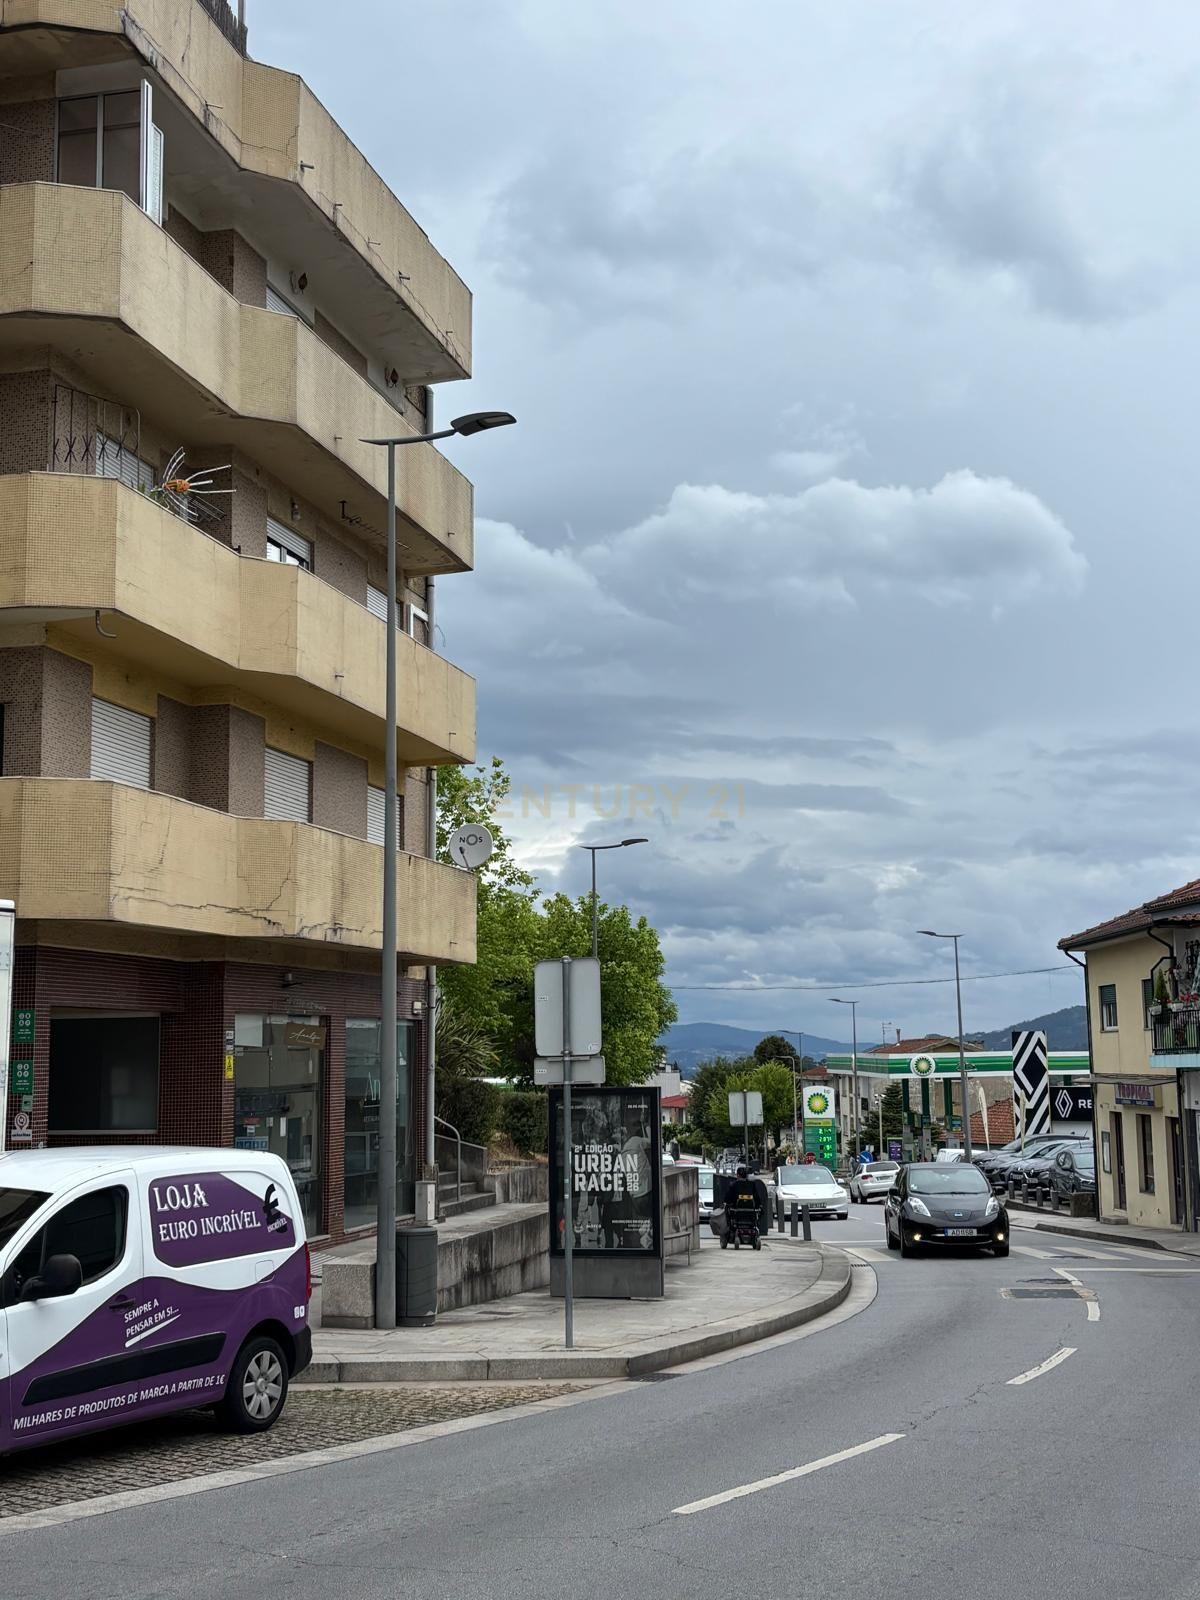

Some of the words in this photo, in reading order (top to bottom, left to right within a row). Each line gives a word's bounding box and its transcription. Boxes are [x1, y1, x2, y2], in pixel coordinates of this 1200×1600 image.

[459, 834, 484, 846] NOS
[1078, 1099, 1092, 1109] RE
[585, 1143, 613, 1155] EDIÇÃO
[574, 1153, 639, 1172] URBAN
[574, 1173, 624, 1192] RACE
[626, 1173, 639, 1182] 20
[626, 1182, 639, 1192] 26
[153, 1183, 209, 1212] LOJA
[159, 1219, 198, 1242] EURO
[200, 1209, 261, 1236] INCRÍVEL
[124, 1301, 152, 1323] SEMPRE
[153, 1298, 159, 1308] A
[126, 1316, 153, 1338] PENSAR
[154, 1309, 166, 1323] EM
[13, 1409, 63, 1430] MILHARES
[64, 1406, 77, 1419] DE
[78, 1395, 126, 1416] PRODUTOS
[127, 1392, 139, 1404] DE
[140, 1384, 169, 1401] MARCA
[170, 1383, 177, 1394] A
[177, 1378, 204, 1392] PARTIR
[204, 1375, 216, 1387] DE
[215, 1374, 226, 1385] 1€
